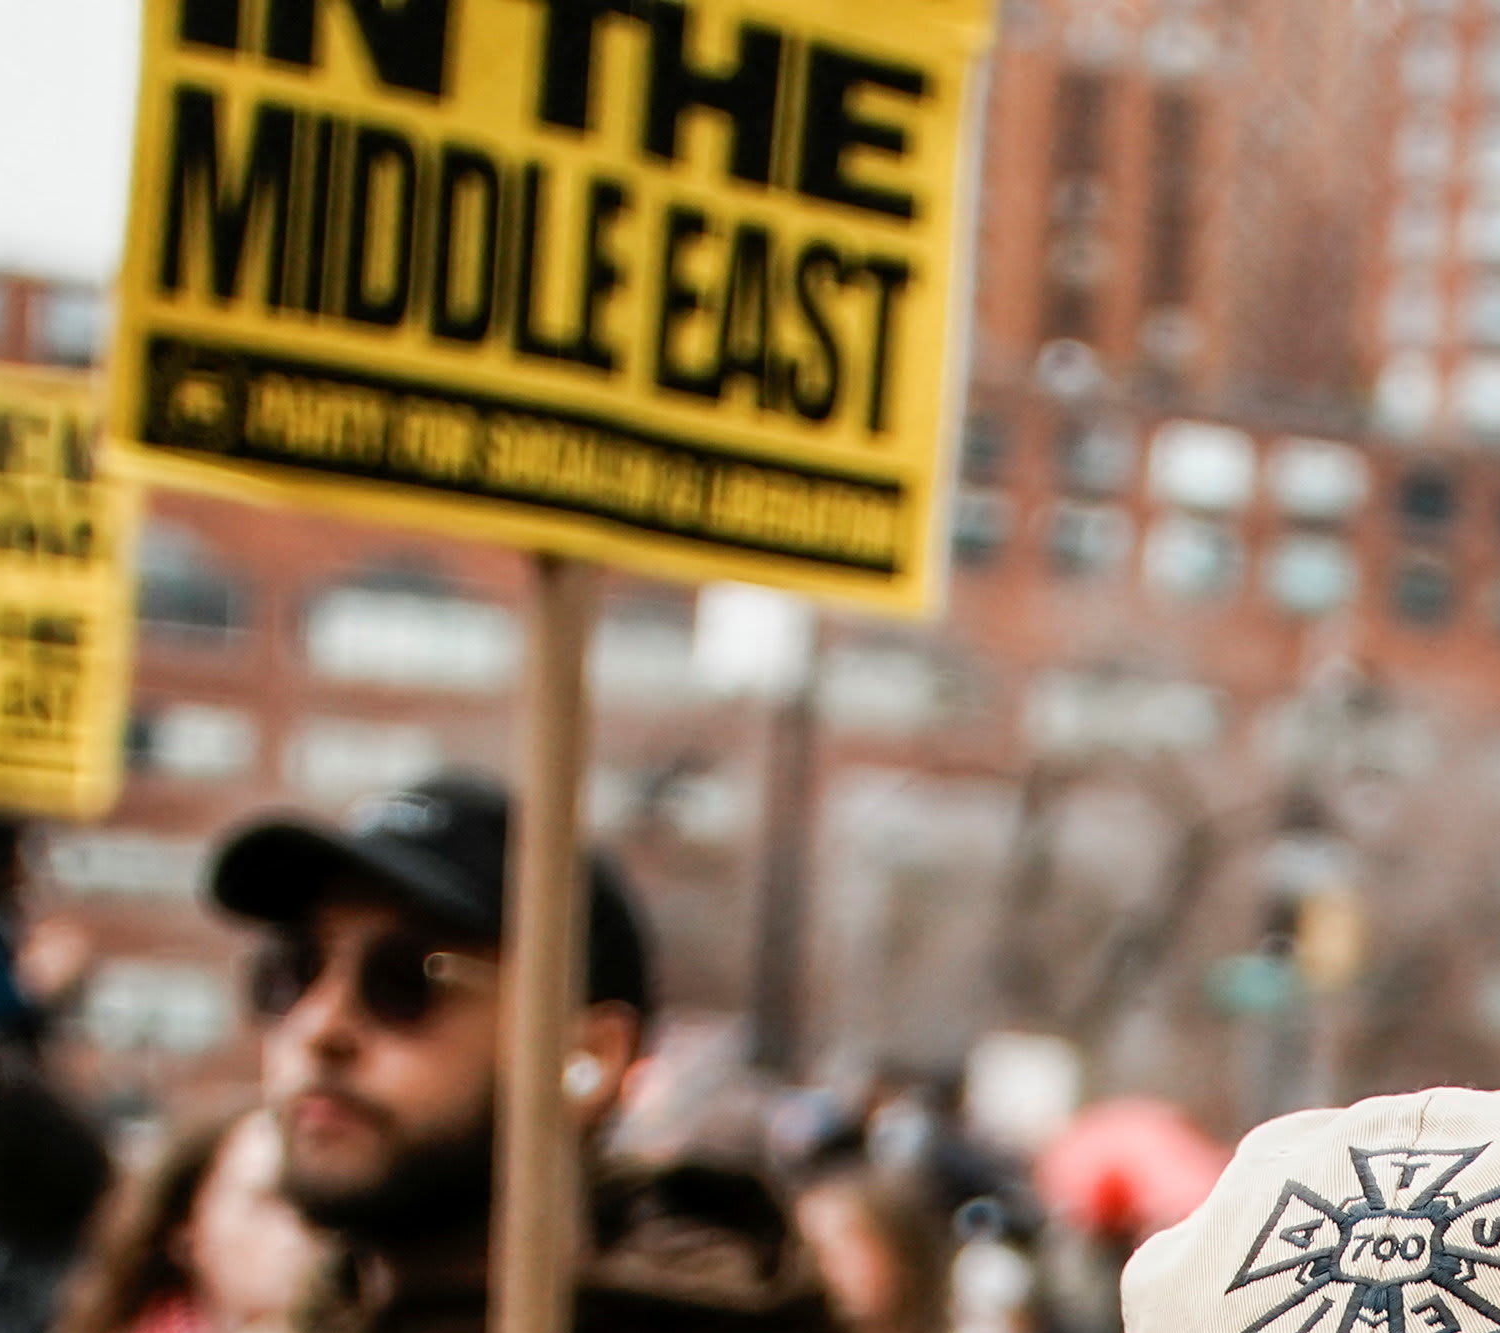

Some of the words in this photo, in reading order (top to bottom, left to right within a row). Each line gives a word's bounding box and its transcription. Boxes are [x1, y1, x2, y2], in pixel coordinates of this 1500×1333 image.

[538, 0, 934, 220] THE
[158, 84, 632, 374] MIDDLE
[656, 208, 918, 434] EAST
[1348, 1232, 1428, 1264] 700
